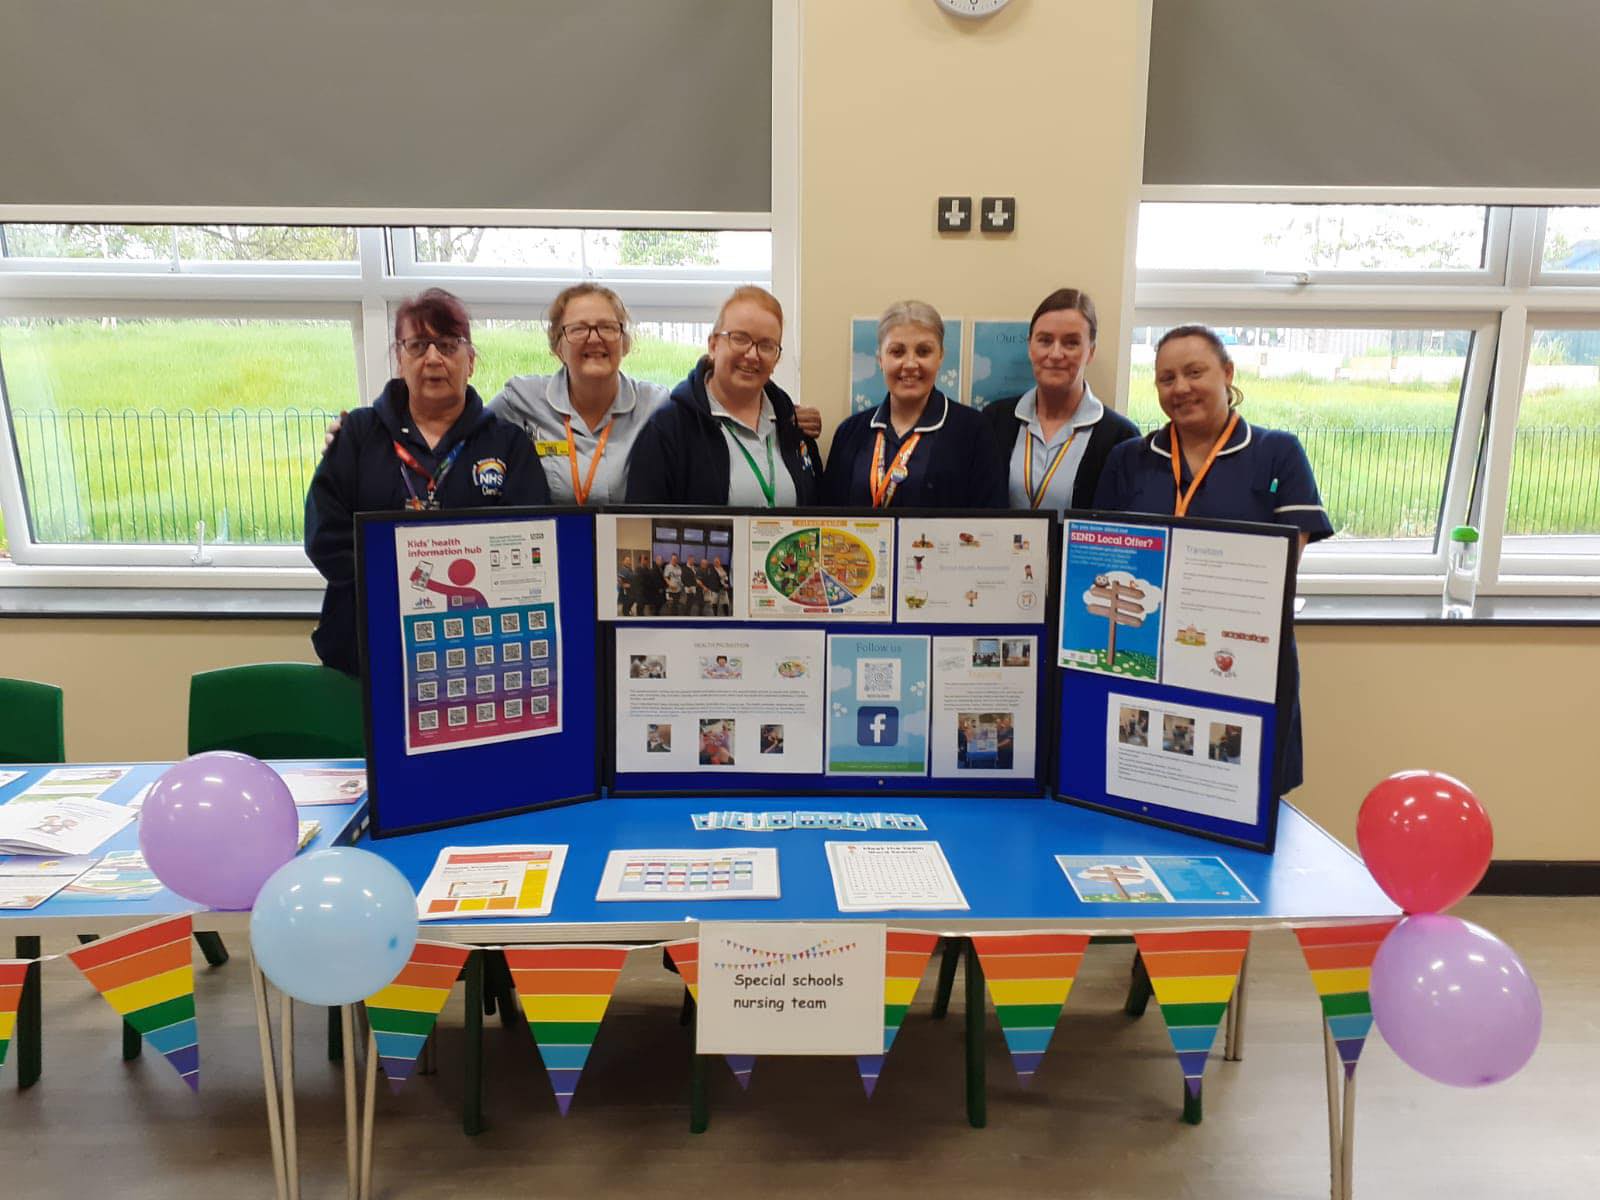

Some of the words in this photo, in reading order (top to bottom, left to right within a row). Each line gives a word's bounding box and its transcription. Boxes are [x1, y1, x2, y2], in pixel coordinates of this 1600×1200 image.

[479, 473, 503, 486] NHS
[431, 537, 461, 547] health
[1071, 532, 1096, 542] SEND
[1097, 534, 1122, 545] Local
[1124, 537, 1153, 549] Offer?
[408, 546, 463, 558] information
[464, 546, 482, 555] hub
[856, 641, 888, 653] Follow
[890, 644, 902, 652] us
[734, 974, 786, 989] Special
[792, 974, 844, 987] schools
[733, 996, 785, 1012] nursing
[791, 997, 827, 1009] team
